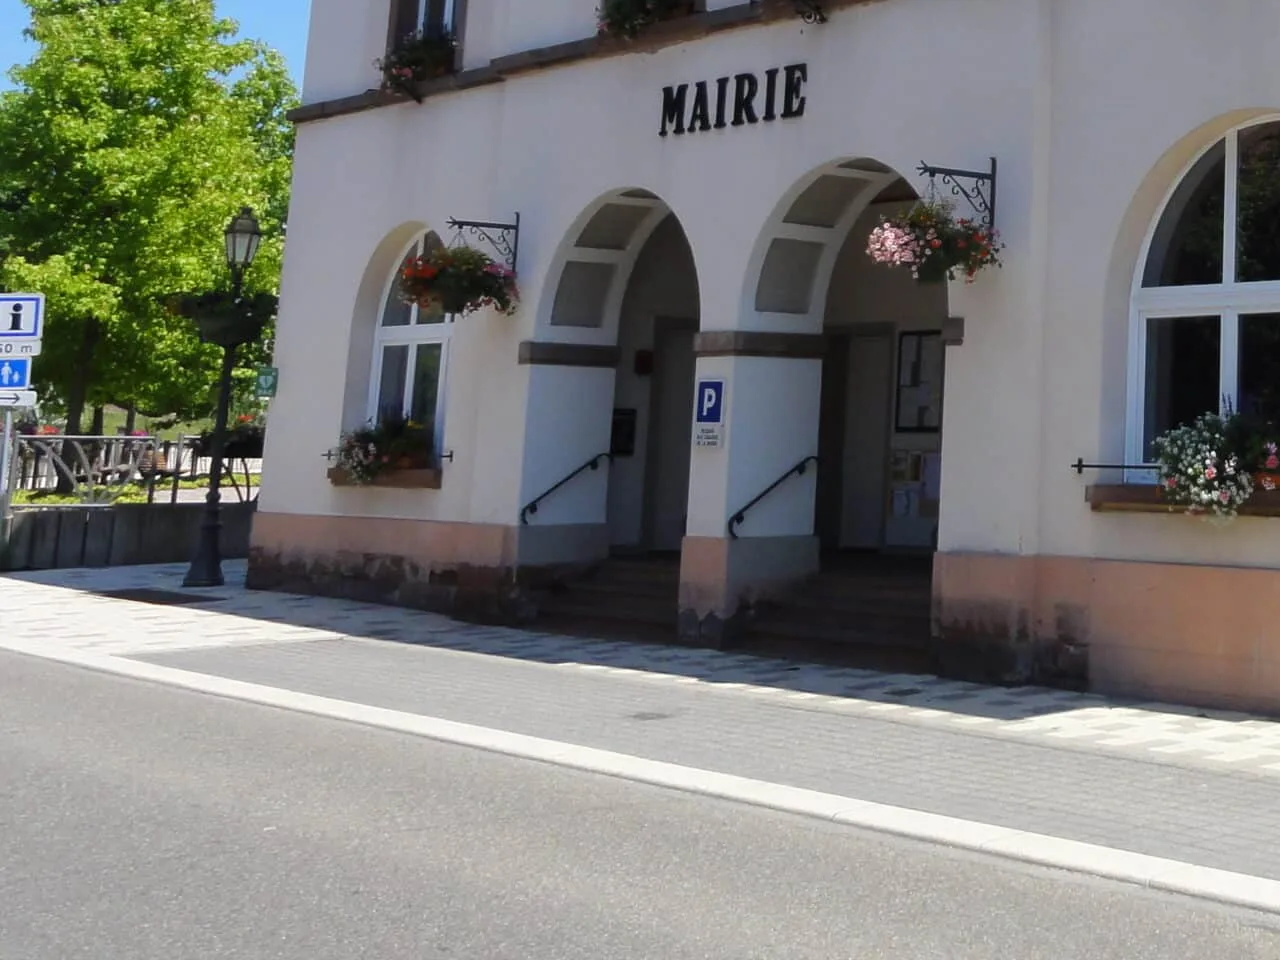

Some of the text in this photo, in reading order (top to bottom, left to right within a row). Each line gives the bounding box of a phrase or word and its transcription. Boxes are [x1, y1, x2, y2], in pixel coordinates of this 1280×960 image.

[658, 63, 808, 137] MAIRIE
[20, 345, 33, 353] m
[702, 388, 716, 416] P
